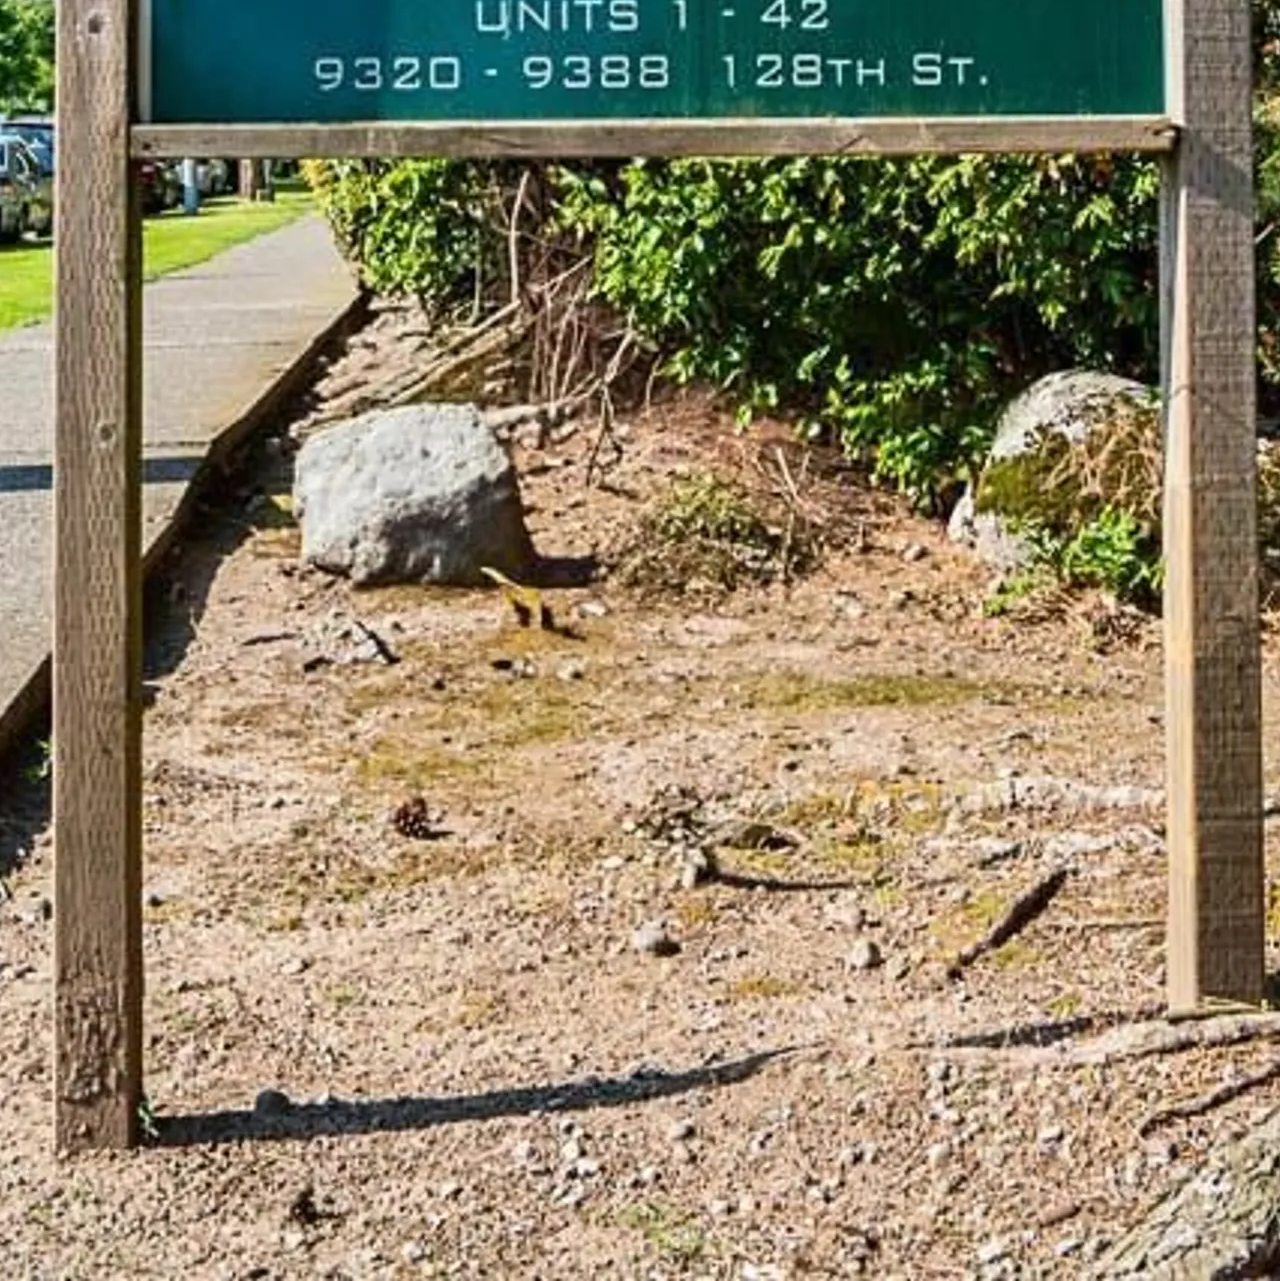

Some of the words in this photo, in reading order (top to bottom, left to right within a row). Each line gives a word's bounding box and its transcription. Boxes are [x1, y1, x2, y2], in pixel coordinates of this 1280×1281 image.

[314, 55, 461, 90] 9320
[522, 54, 670, 89] 9388
[722, 52, 885, 88] 128TH
